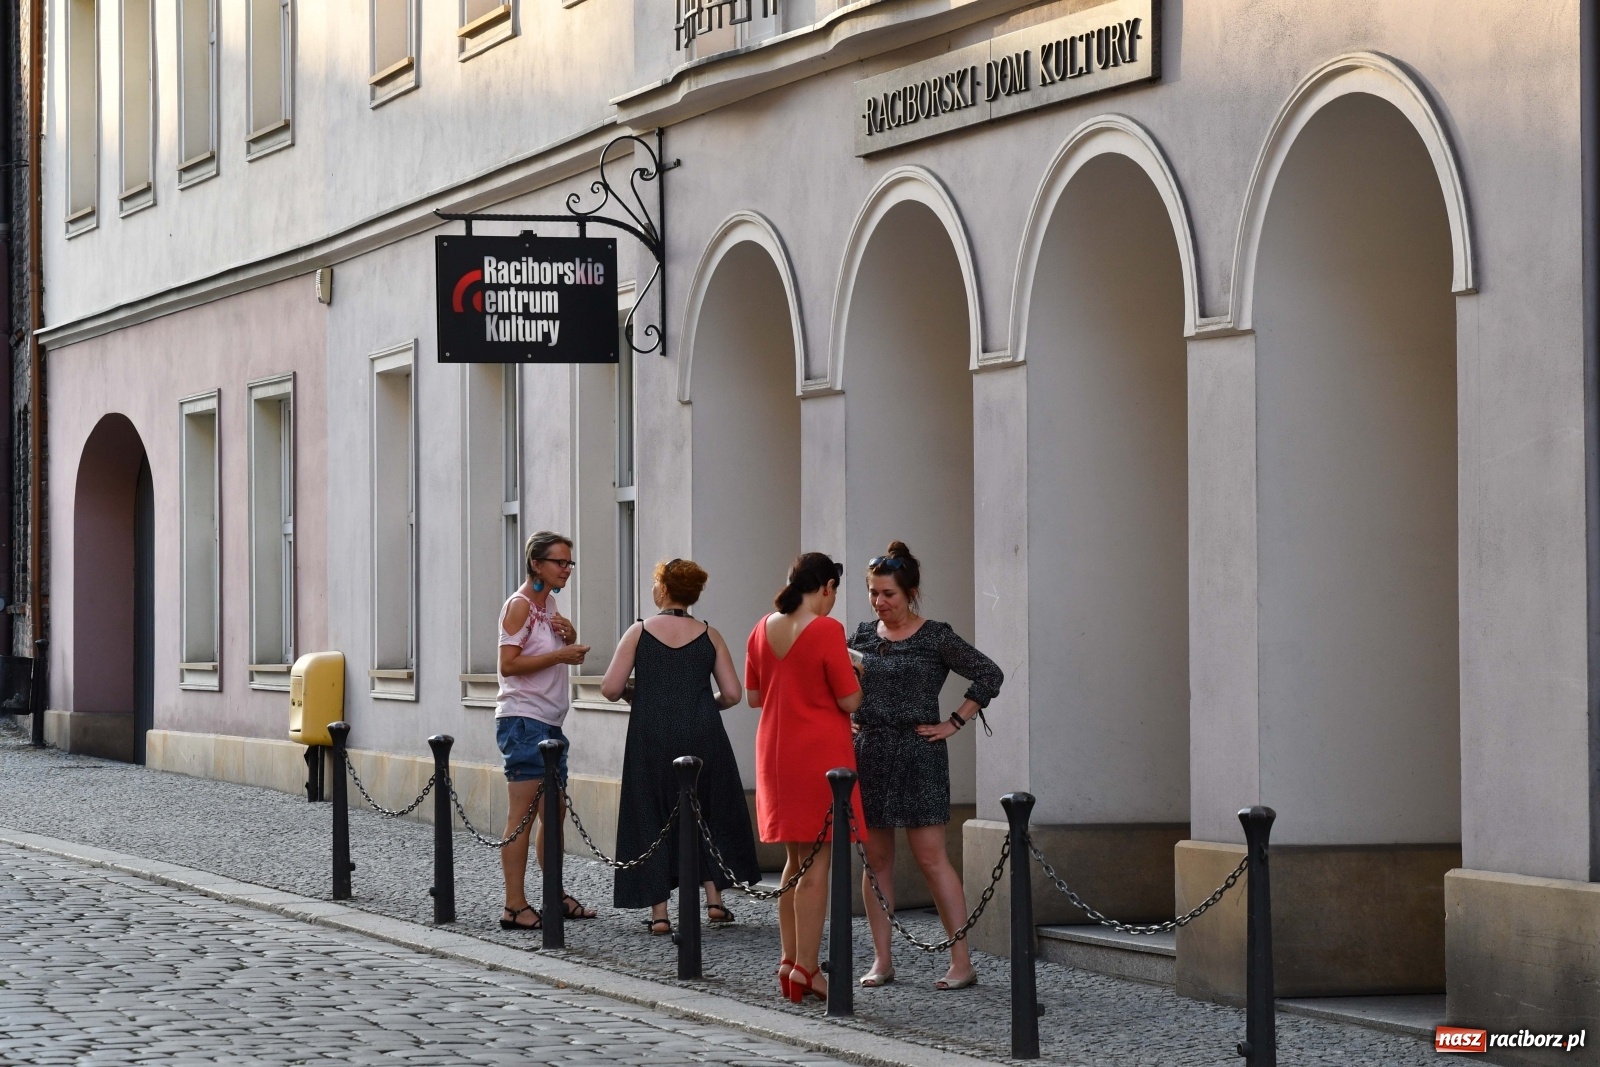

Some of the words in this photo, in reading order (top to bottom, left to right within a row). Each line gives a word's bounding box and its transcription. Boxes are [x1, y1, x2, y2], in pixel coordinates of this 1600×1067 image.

[984, 50, 1031, 101] DOM
[1038, 18, 1142, 86] KULTURY
[484, 255, 604, 285] Raciborskie
[486, 315, 560, 346] Kultury
